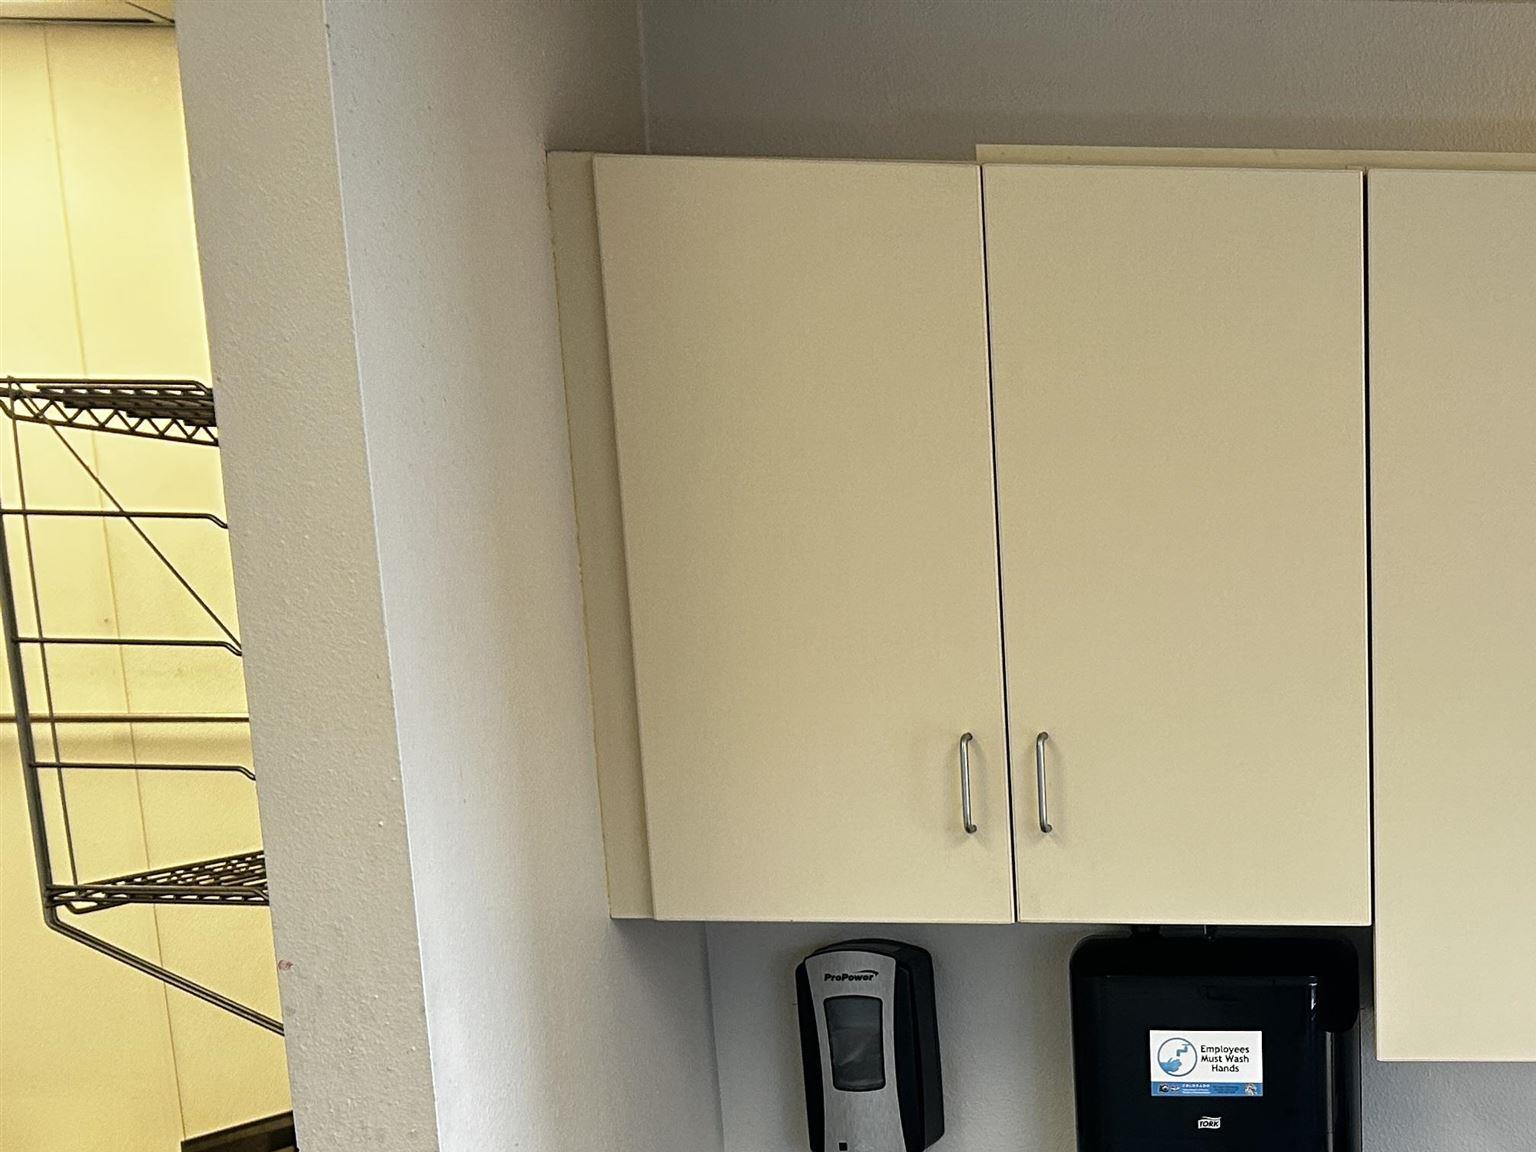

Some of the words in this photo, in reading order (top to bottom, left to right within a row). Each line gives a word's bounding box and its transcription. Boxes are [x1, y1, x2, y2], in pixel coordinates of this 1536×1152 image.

[824, 973, 874, 982] ProPower
[1200, 1045, 1250, 1054] Employees
[1201, 1055, 1222, 1063] Must
[1225, 1055, 1249, 1063] Wash
[1211, 1065, 1239, 1073] Hands
[1199, 1120, 1220, 1128] TORK
